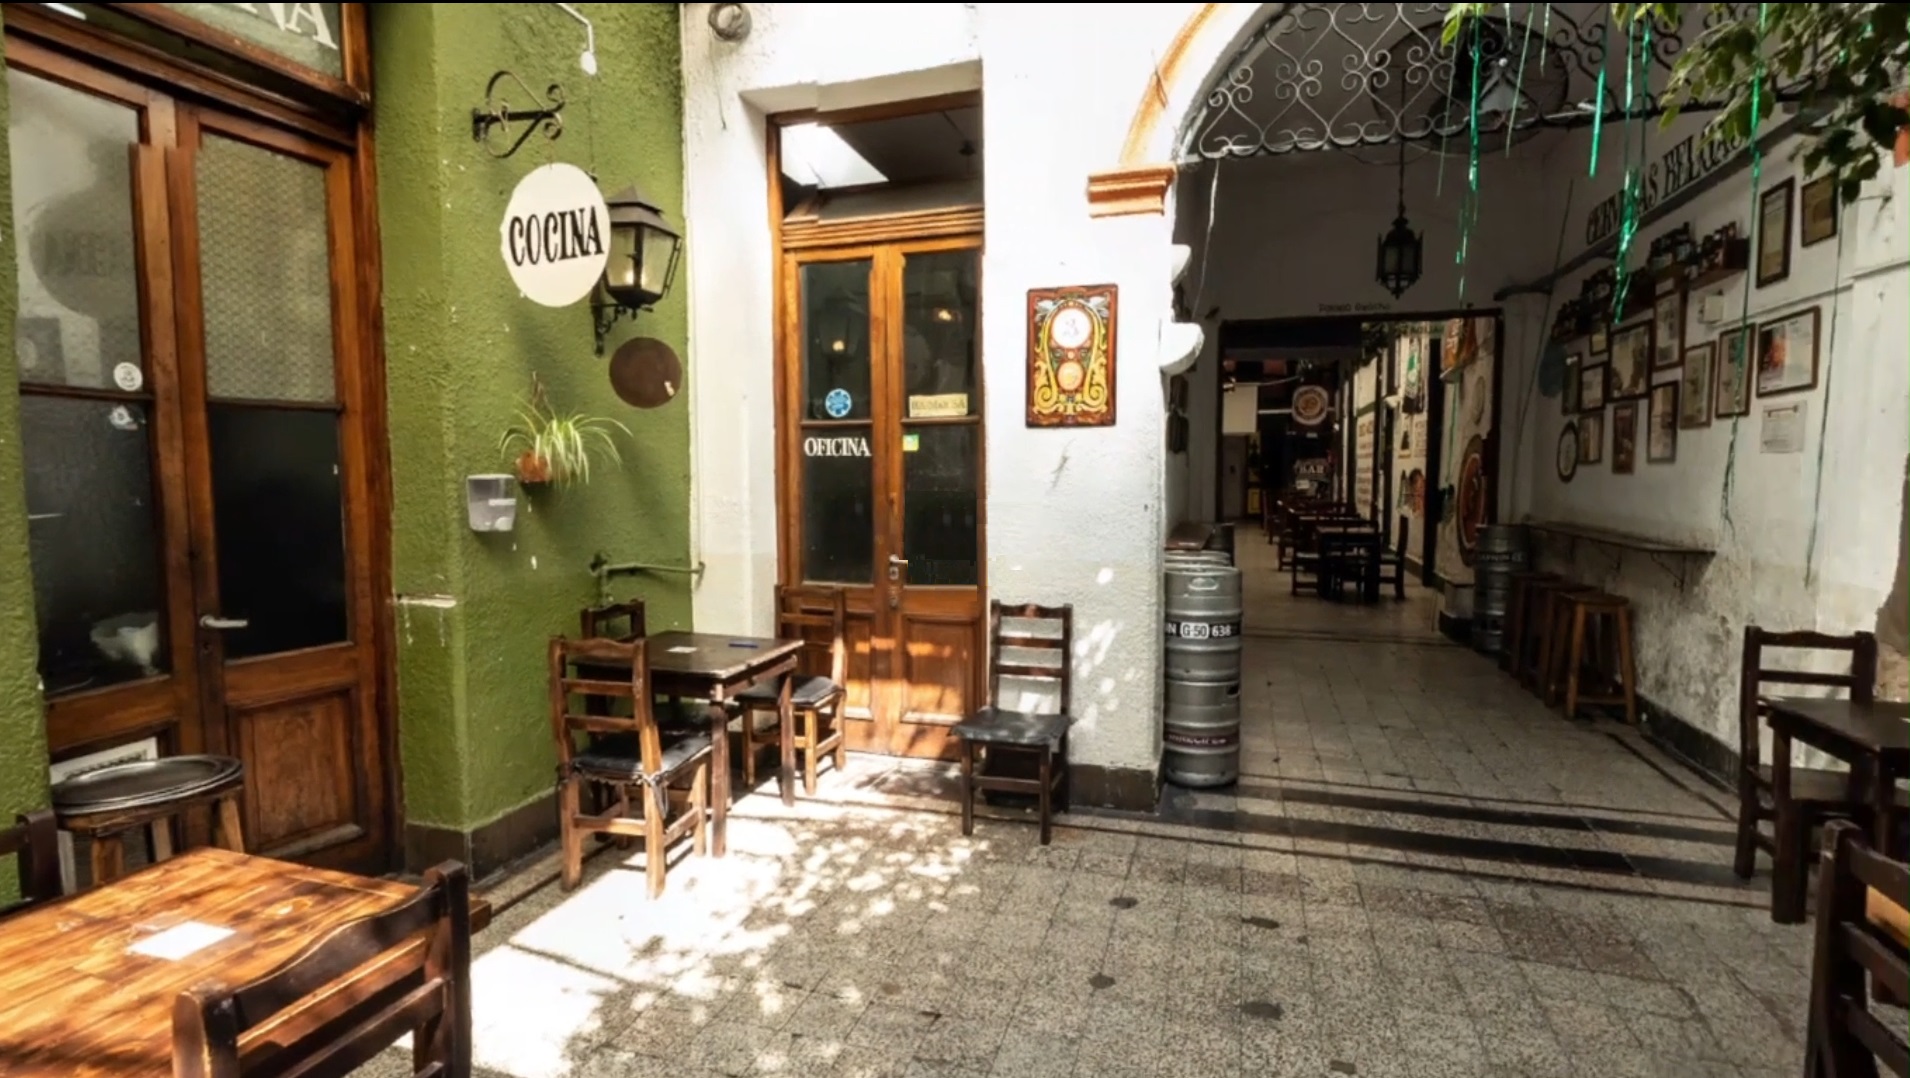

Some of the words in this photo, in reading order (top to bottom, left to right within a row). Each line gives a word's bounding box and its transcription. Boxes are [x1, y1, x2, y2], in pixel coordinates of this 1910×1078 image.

[1586, 162, 1659, 246] CERVAS
[509, 205, 604, 267] COCINA
[804, 436, 872, 457] OFICINA
[1211, 624, 1232, 637] 638
